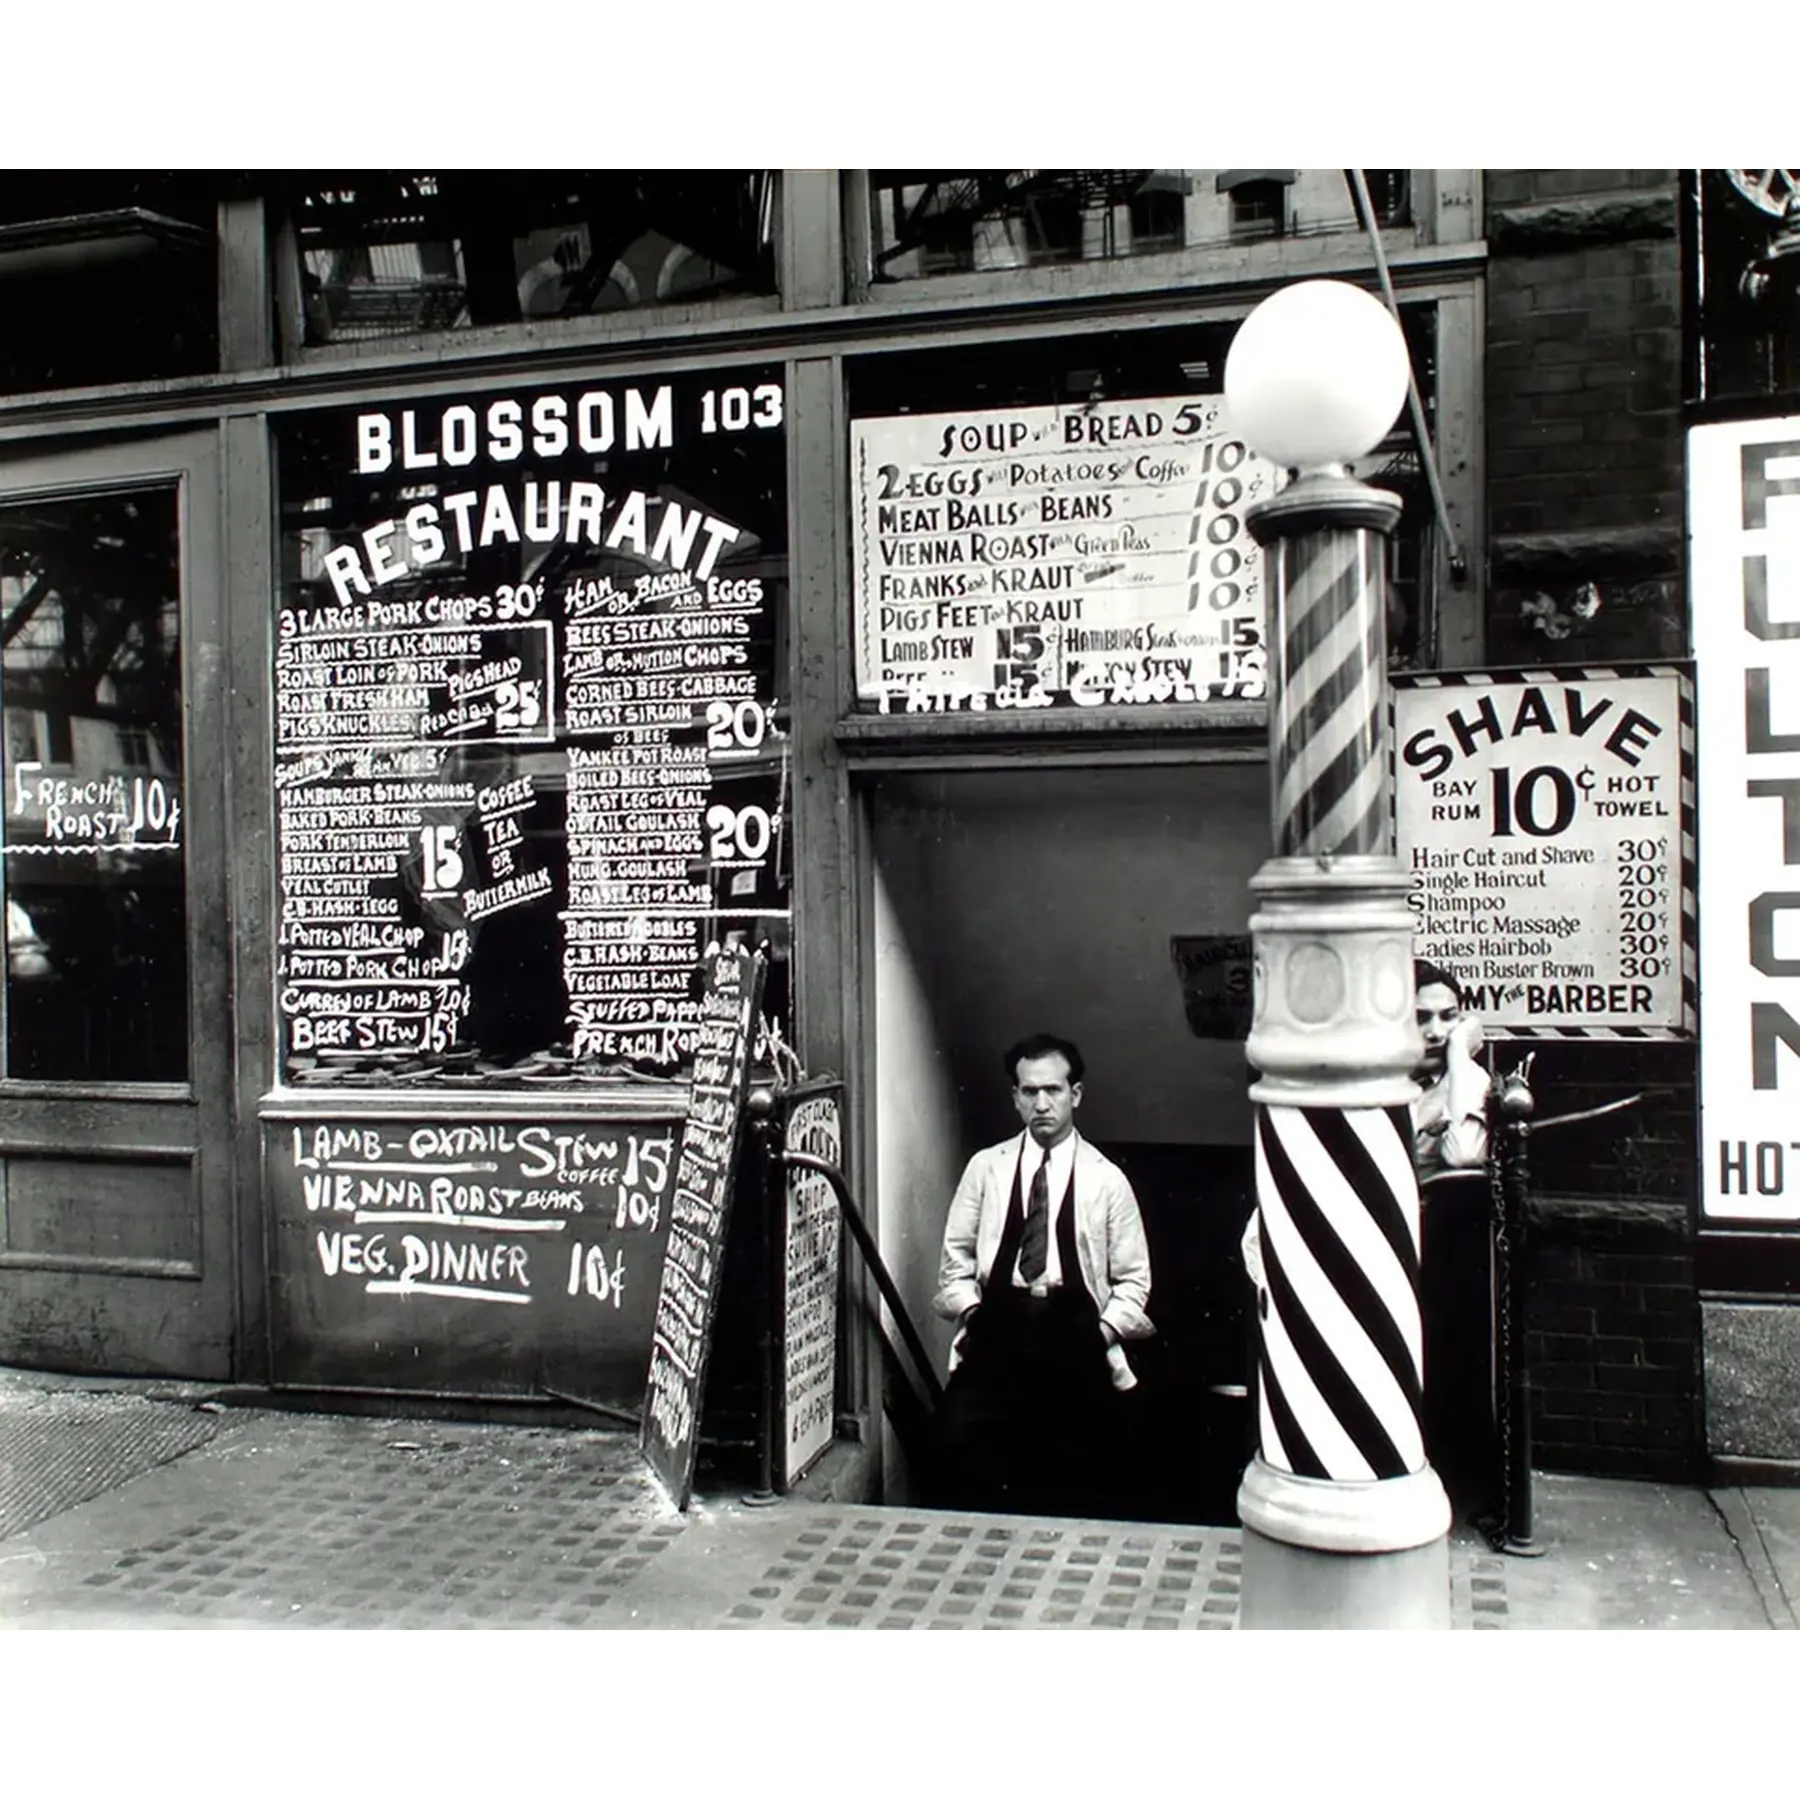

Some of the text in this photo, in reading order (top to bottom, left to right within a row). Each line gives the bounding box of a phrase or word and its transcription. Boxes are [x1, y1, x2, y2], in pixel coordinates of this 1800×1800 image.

[357, 384, 784, 474] BLOSSOM 103
[939, 422, 1028, 458] SOUP
[1064, 412, 1163, 447] BREAD
[879, 494, 1112, 534] MEAT BALLS BEANS
[323, 480, 741, 607] RESTAURANT
[879, 539, 964, 567] VIENNA
[971, 533, 1051, 567] ROAST
[564, 576, 614, 614] HAM
[634, 569, 693, 600] BACON
[671, 591, 703, 609] AND
[707, 577, 763, 603] EGGS
[880, 574, 967, 602] FRANKS
[992, 565, 1074, 593] KRAUT
[280, 609, 297, 638] 3
[298, 605, 363, 633] LARGE
[367, 600, 423, 626] PORK
[425, 596, 493, 621] CHOPS
[880, 606, 932, 632] PIGS
[937, 601, 993, 629] FEET
[1007, 598, 1084, 623] KRAUT
[277, 643, 350, 665] SIRLOIN
[684, 645, 748, 666] CHOPS
[881, 638, 929, 663] LAMB
[931, 634, 974, 661] STEW
[1064, 627, 1143, 652] HAMBURG
[277, 661, 449, 689] ROAST LOIN PORK
[277, 692, 328, 713] ROAST
[391, 687, 430, 708] HAM
[565, 681, 633, 705] CORNED
[279, 715, 322, 740] PIGS
[565, 708, 621, 730] ROAST
[626, 703, 692, 724] SIRLOIN
[1403, 687, 1662, 782] SHAVE
[566, 746, 709, 768] YANKEE POT ROAST
[14, 761, 113, 816] FRENCH
[280, 785, 374, 807] HAMBURGER
[479, 775, 536, 812] COFFEE
[566, 789, 708, 814] ROAST LEG VEAL
[1432, 764, 1661, 837] BAY 10¢ HOT
[45, 777, 181, 843] ROAST 10¢
[626, 813, 699, 832] GOULASH
[1431, 801, 1669, 820] RUM TOWEL
[281, 834, 322, 852] PORK
[484, 817, 520, 846] TEA
[566, 837, 639, 856] SPINACH
[1412, 846, 1459, 869] Hair
[1463, 847, 1496, 867] Cut
[1502, 848, 1538, 866] and
[1542, 845, 1595, 865] Shave
[353, 853, 398, 873] LAMB
[617, 859, 687, 878] GOULASH
[281, 879, 371, 896] VEAL CUTLET
[462, 866, 552, 918] BUTTERMILK
[1475, 869, 1547, 889] Haircut
[1407, 893, 1506, 919] Shampoo
[291, 921, 424, 948] POTTED VEAL CHOP
[1493, 915, 1580, 939] Massage
[1479, 937, 1551, 957] Hairbob
[290, 954, 441, 979] POTTED PORK CHOP
[1483, 960, 1539, 979] Buster
[1542, 960, 1595, 979] Brown
[564, 969, 692, 992] VEGETABLE LOAF
[376, 988, 432, 1011] LAMB
[1527, 984, 1654, 1015] BARBER
[292, 1016, 351, 1051] BEEF
[356, 1016, 418, 1048] STEW
[517, 1127, 618, 1178] STEW
[622, 1125, 674, 1193] 15¢
[556, 1165, 620, 1185] COFFEE
[303, 1174, 426, 1212] VIENNA
[429, 1177, 522, 1217] ROAST
[615, 1184, 660, 1233] 10¢
[316, 1231, 396, 1278] VEG.
[399, 1234, 532, 1288] DINNER
[566, 1241, 626, 1309] 10¢
